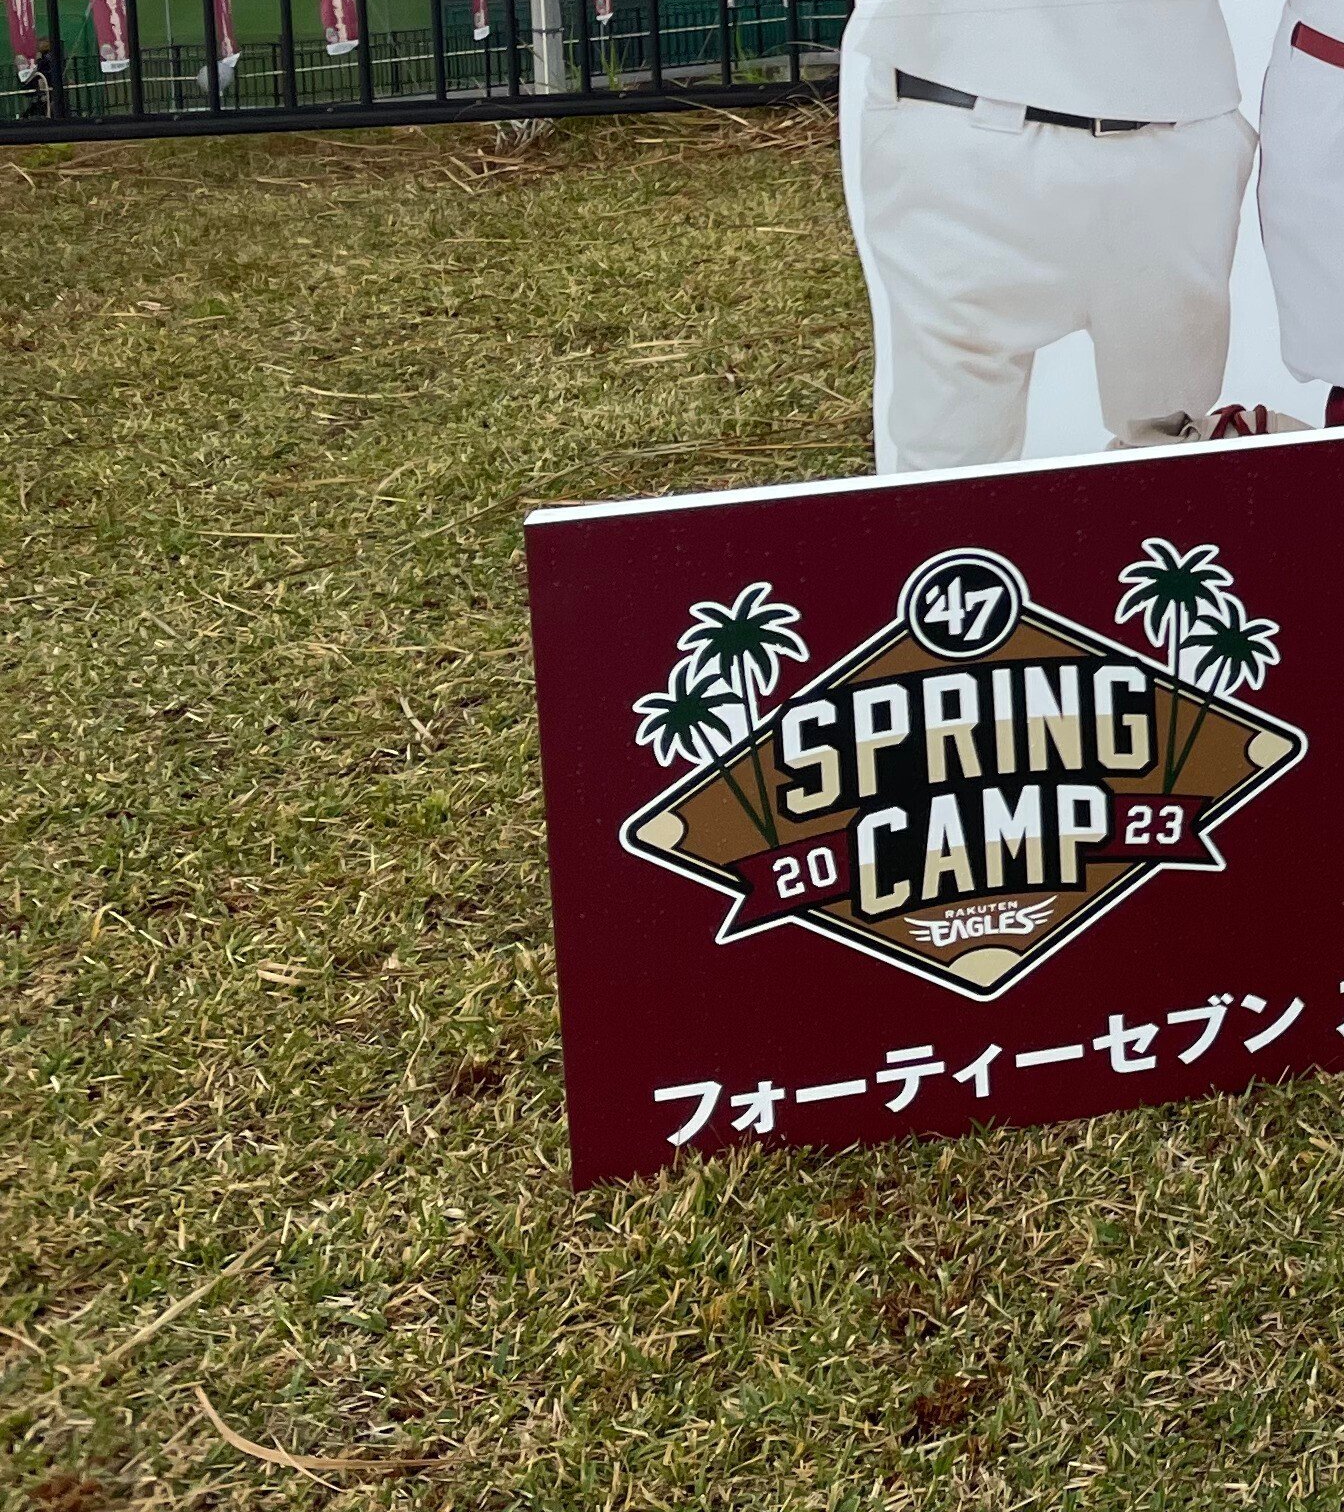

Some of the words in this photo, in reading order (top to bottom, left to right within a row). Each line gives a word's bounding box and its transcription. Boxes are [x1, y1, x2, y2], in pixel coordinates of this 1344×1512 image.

[779, 665, 1152, 816] SPRING
[772, 846, 838, 899] 20
[1123, 805, 1184, 845] 23
[856, 784, 1109, 916] CAMP
[904, 894, 1058, 947] EAGLES
[945, 900, 1018, 919] RAKUTEN
[653, 993, 1305, 1148] フォーティーセブン
